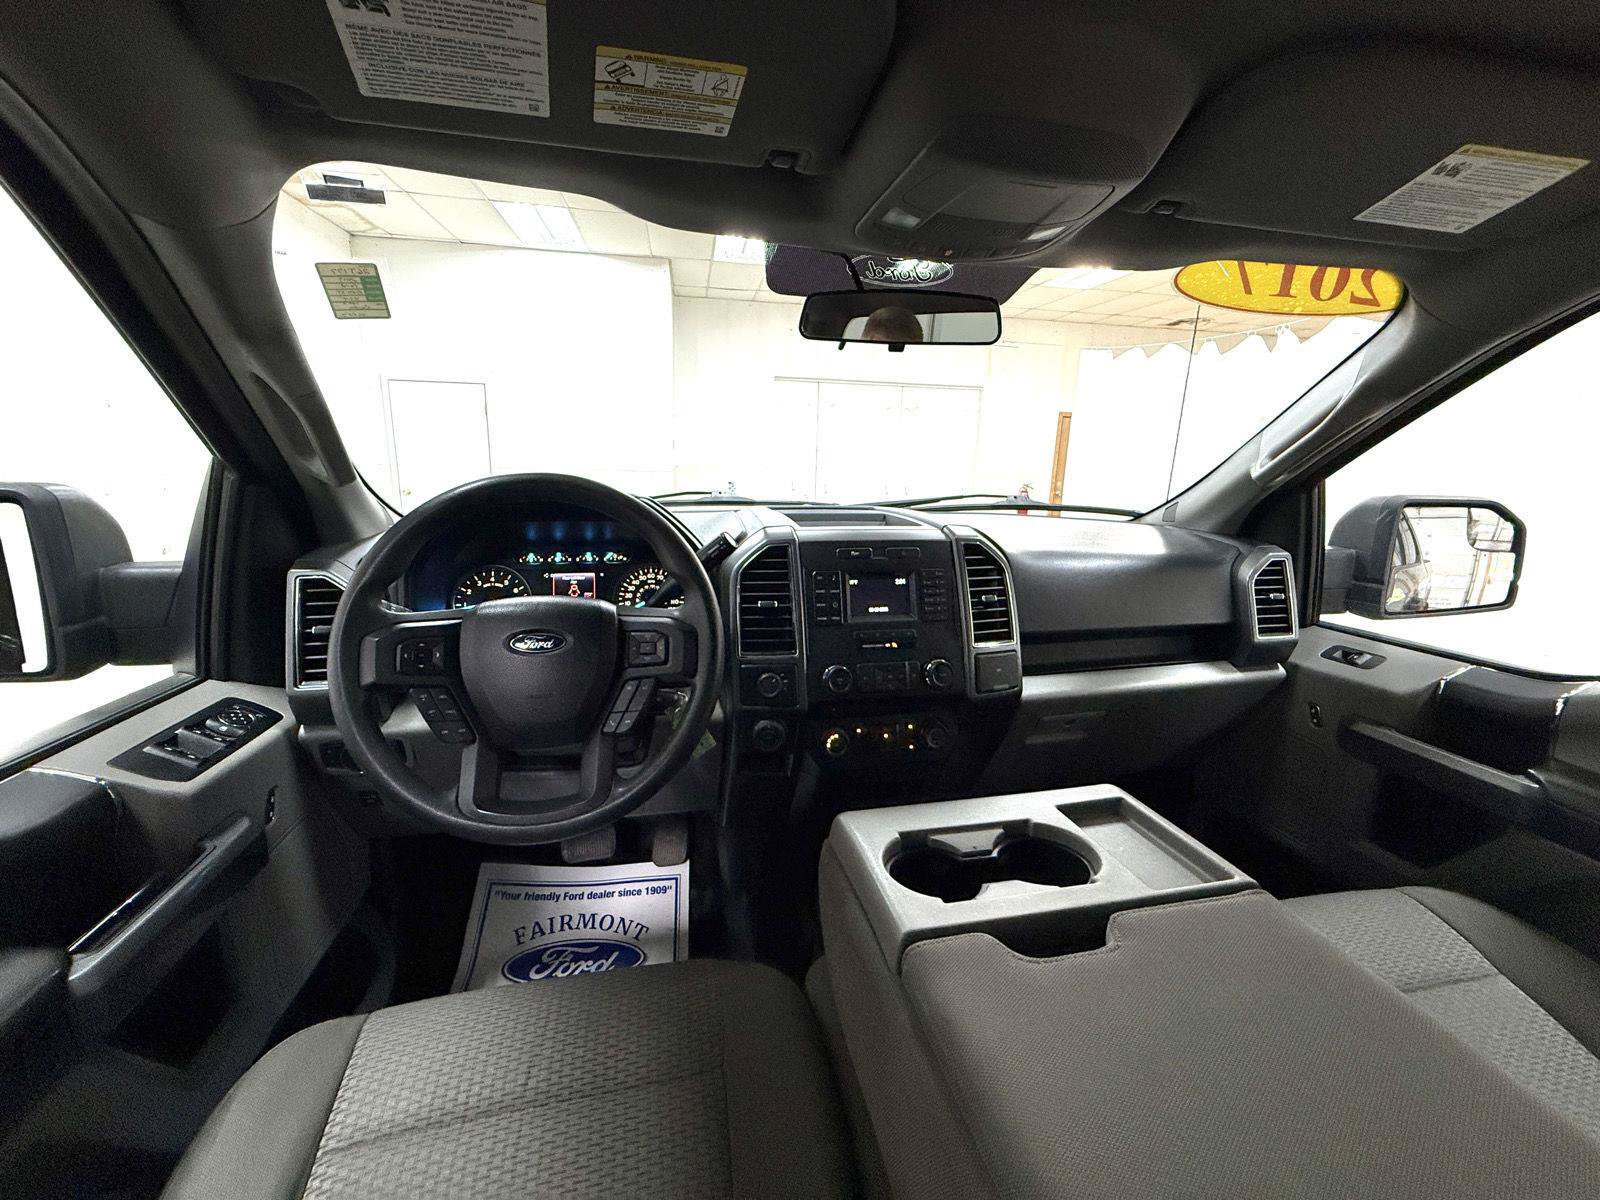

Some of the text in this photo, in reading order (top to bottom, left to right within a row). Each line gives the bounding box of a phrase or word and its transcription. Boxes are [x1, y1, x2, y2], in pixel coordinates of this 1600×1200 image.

[514, 635, 554, 649] Ford
[523, 891, 561, 903] friendly
[563, 891, 585, 901] Ford
[587, 889, 616, 900] dealer
[617, 888, 642, 898] since
[513, 912, 650, 947] FAIRMONT
[529, 946, 620, 979] Ford
